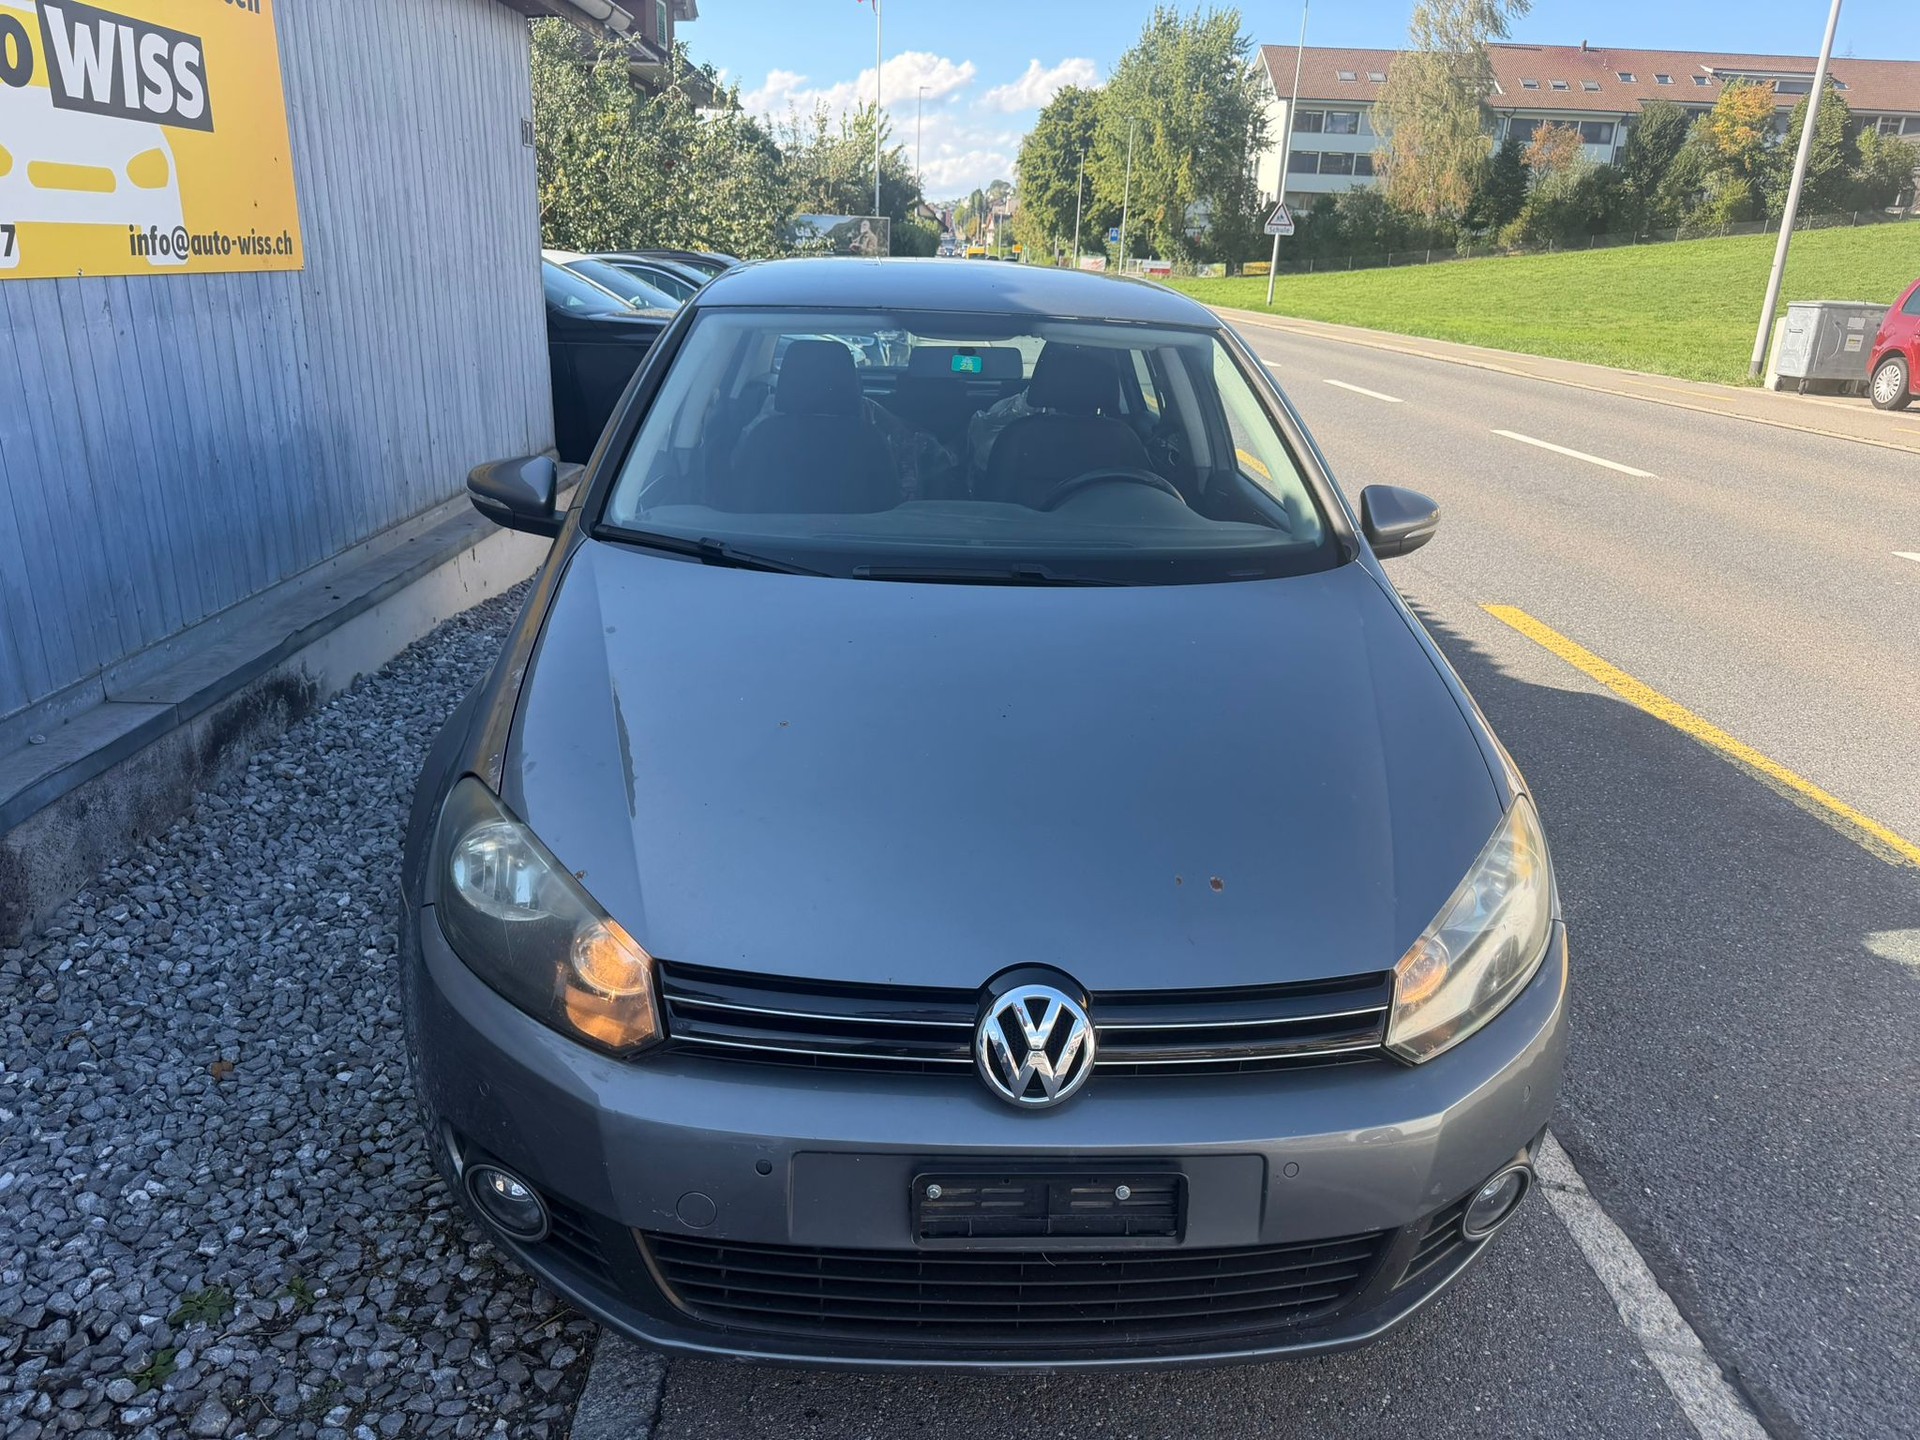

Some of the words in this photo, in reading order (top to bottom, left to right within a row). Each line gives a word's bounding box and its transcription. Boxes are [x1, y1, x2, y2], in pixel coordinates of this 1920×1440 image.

[43, 3, 205, 120] WISS
[128, 224, 293, 261] info@auto-wiss.ch
[1268, 225, 1291, 235] Schule
[982, 991, 1090, 1103] VW
